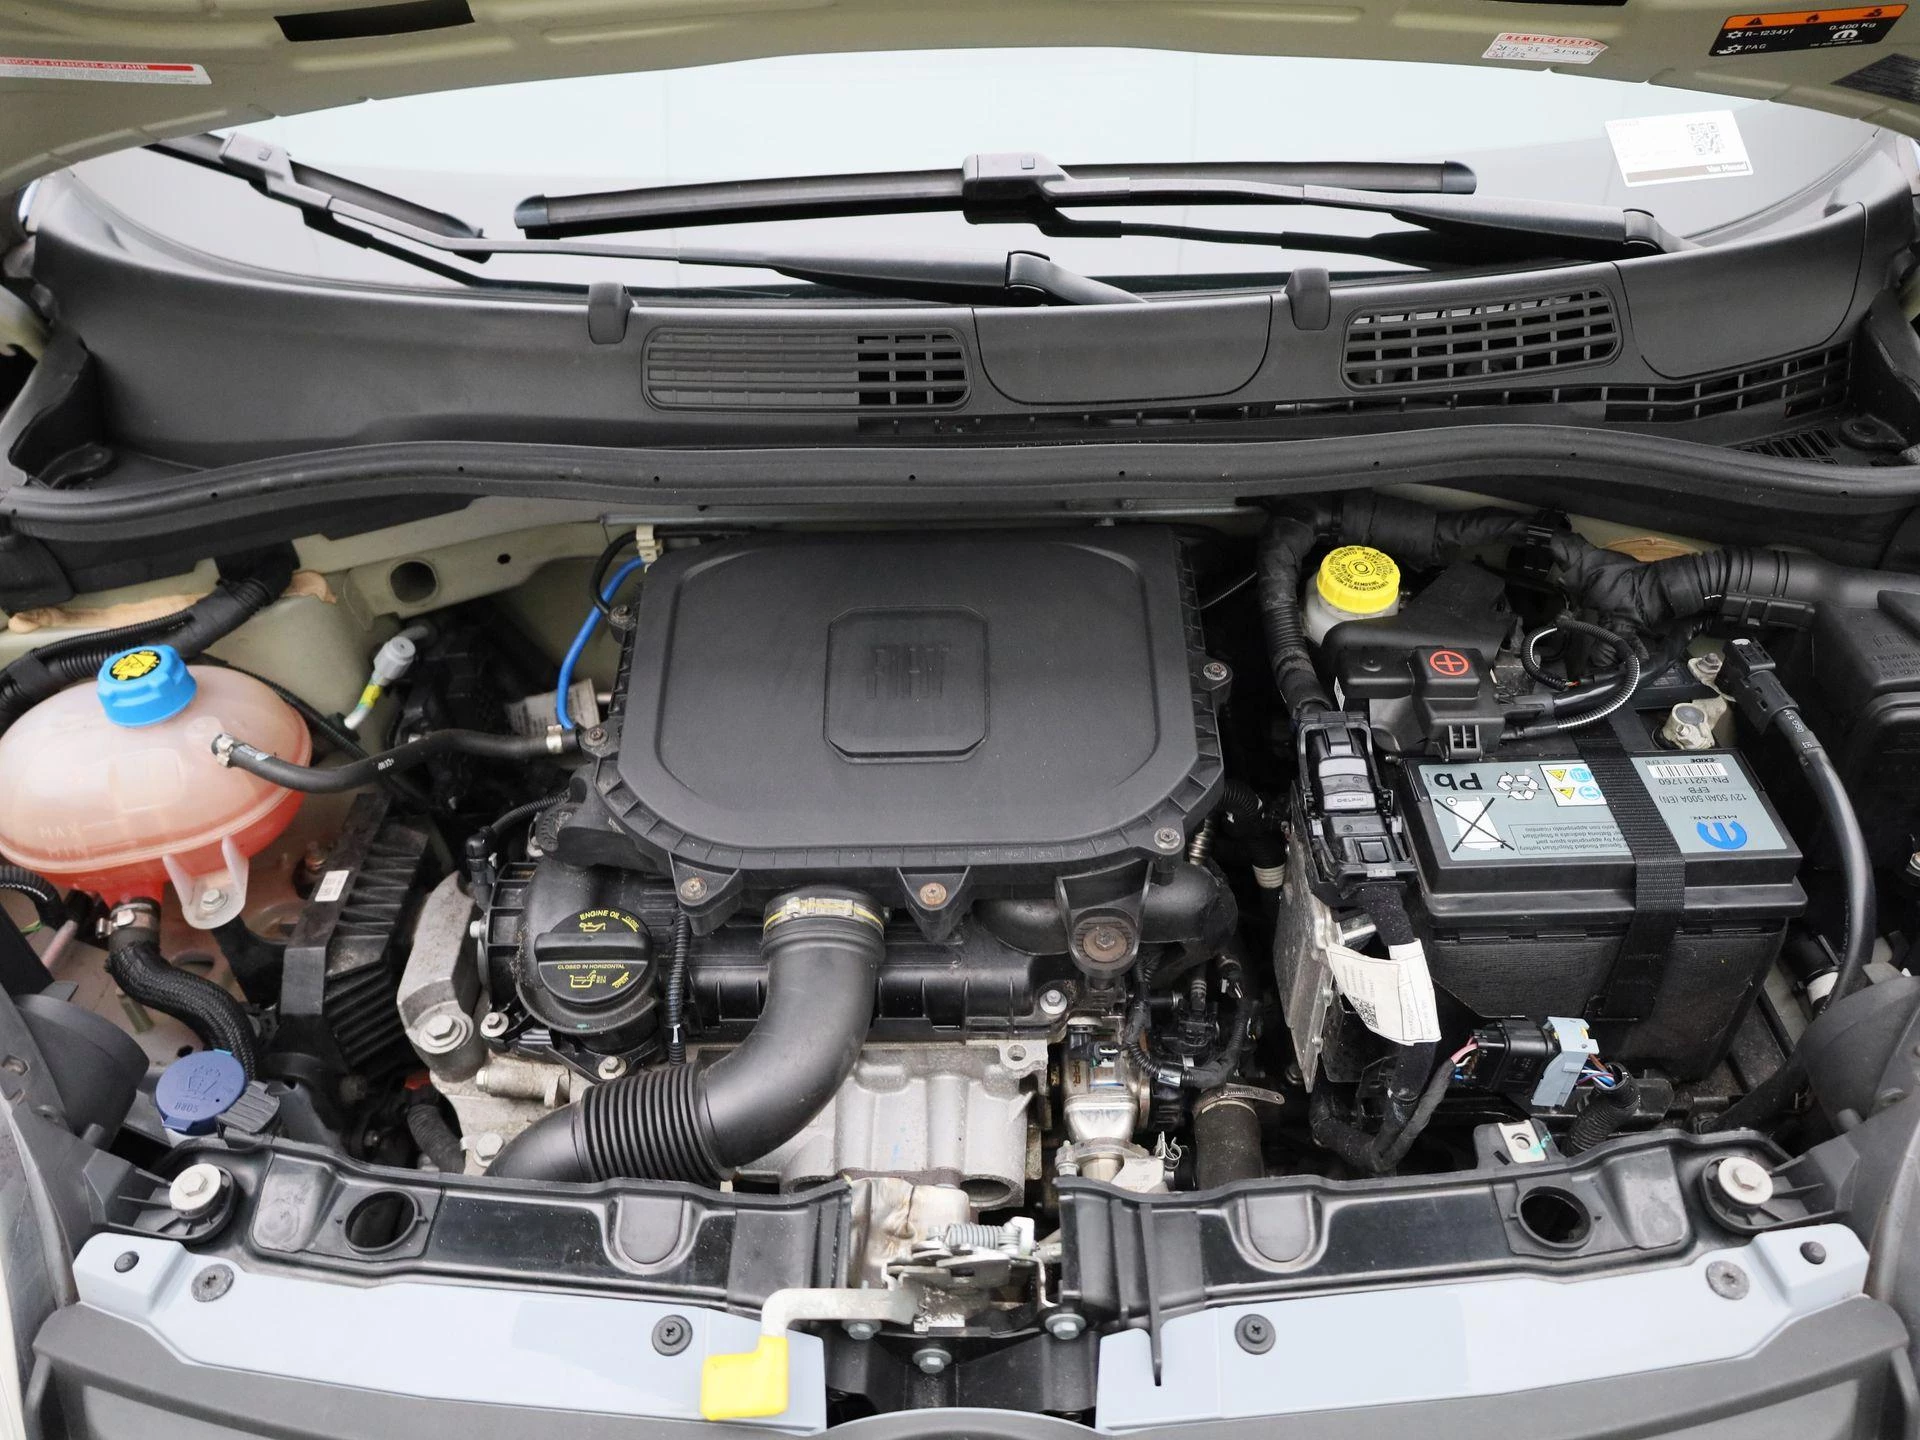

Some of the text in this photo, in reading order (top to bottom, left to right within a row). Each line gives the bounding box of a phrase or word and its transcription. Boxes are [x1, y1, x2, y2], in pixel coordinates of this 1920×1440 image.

[1744, 28, 1795, 38] R-1234yf
[1828, 23, 1857, 32] 0.400
[1434, 772, 1483, 790] Pb
[1658, 777, 1708, 785] 52111760
[1658, 793, 1747, 804] 12V 50Ah 500A (EN)
[38, 822, 81, 839] MAX
[579, 909, 620, 921] ENGINE OIL
